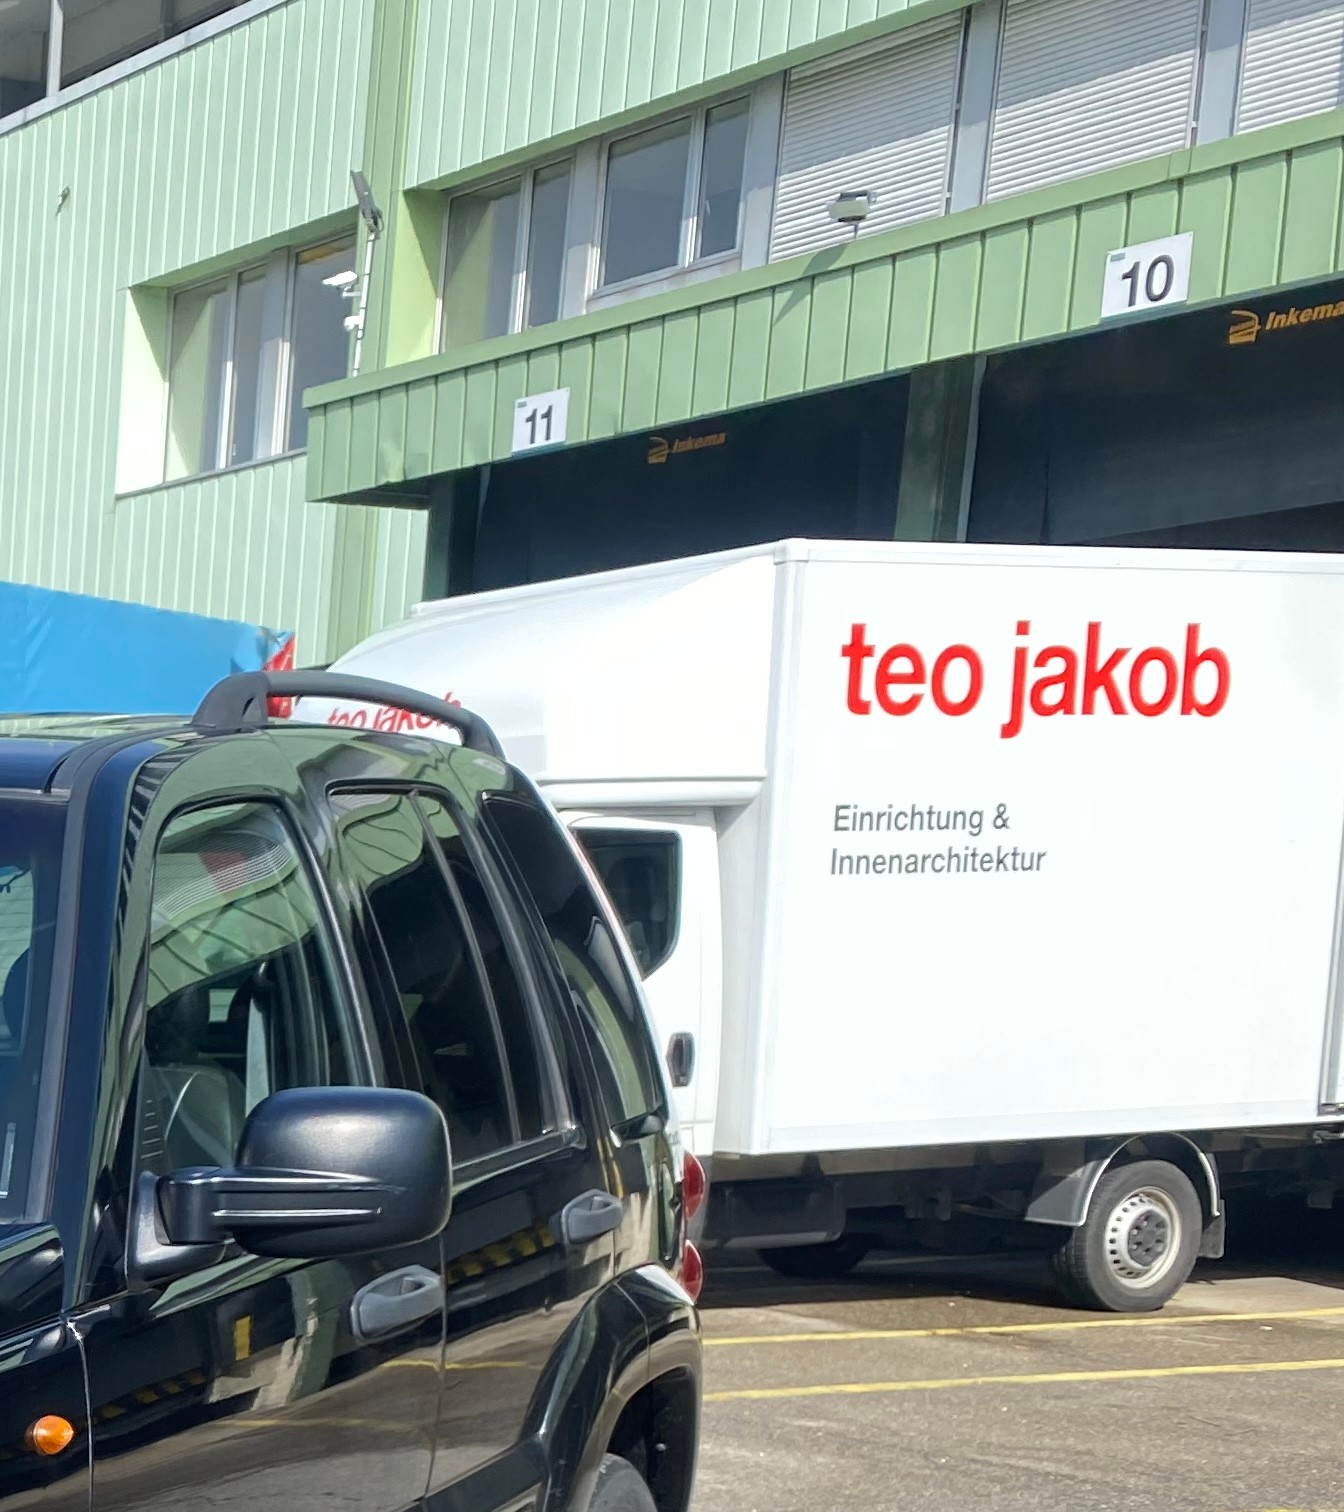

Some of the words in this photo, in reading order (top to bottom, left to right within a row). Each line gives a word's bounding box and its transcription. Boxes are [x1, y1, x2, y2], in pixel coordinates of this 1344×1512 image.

[1122, 254, 1174, 307] 10
[1266, 301, 1344, 330] Inkema
[525, 405, 553, 444] 11
[841, 624, 983, 717] teo
[1000, 620, 1230, 739] jakob
[834, 804, 983, 835] Einrichtung
[992, 804, 1010, 830] &
[830, 847, 1046, 876] Innenarchitektur
